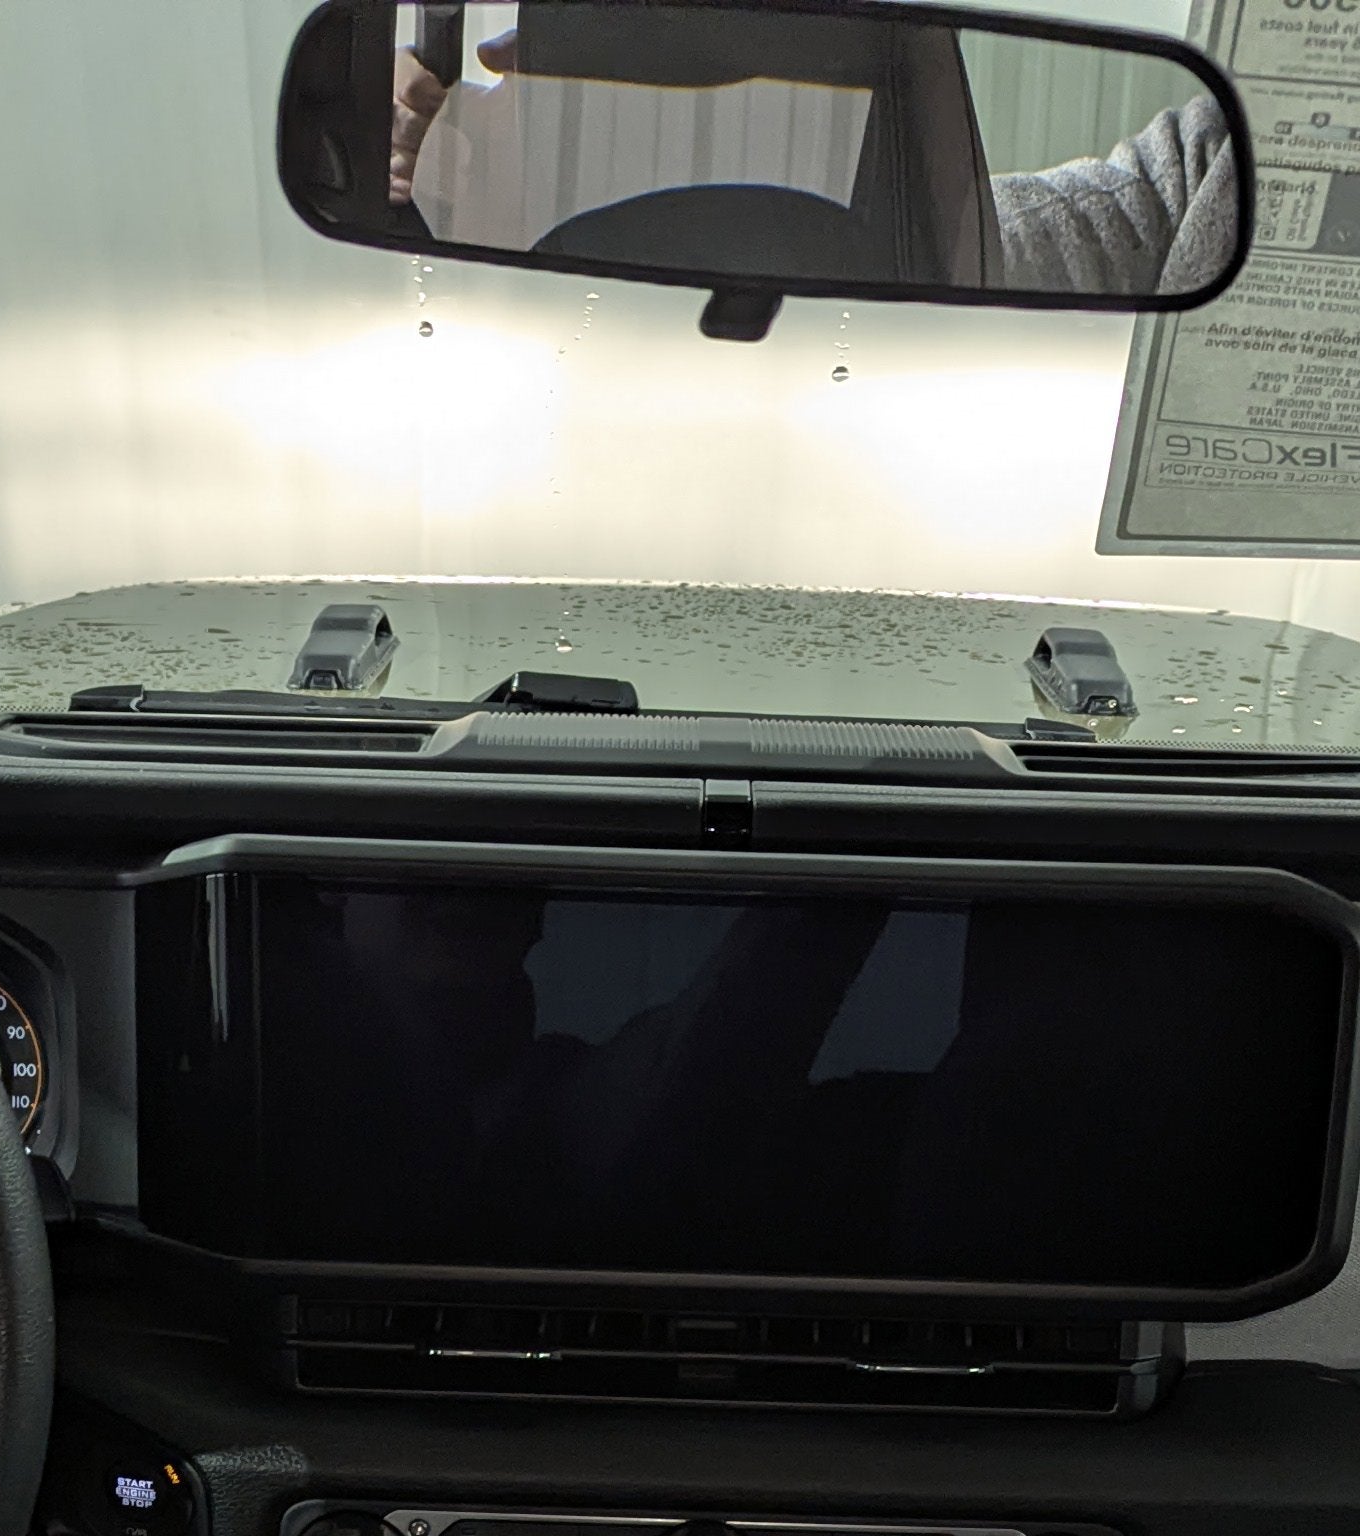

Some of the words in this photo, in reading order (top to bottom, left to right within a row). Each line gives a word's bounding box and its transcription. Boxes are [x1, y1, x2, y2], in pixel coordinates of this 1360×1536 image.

[1207, 323, 1238, 336] Afin
[6, 1025, 26, 1040] 90
[13, 1063, 37, 1079] 100
[11, 1096, 31, 1109] 110
[116, 1477, 154, 1490] START
[115, 1487, 157, 1501] ENGINE
[121, 1498, 153, 1509] STOP
